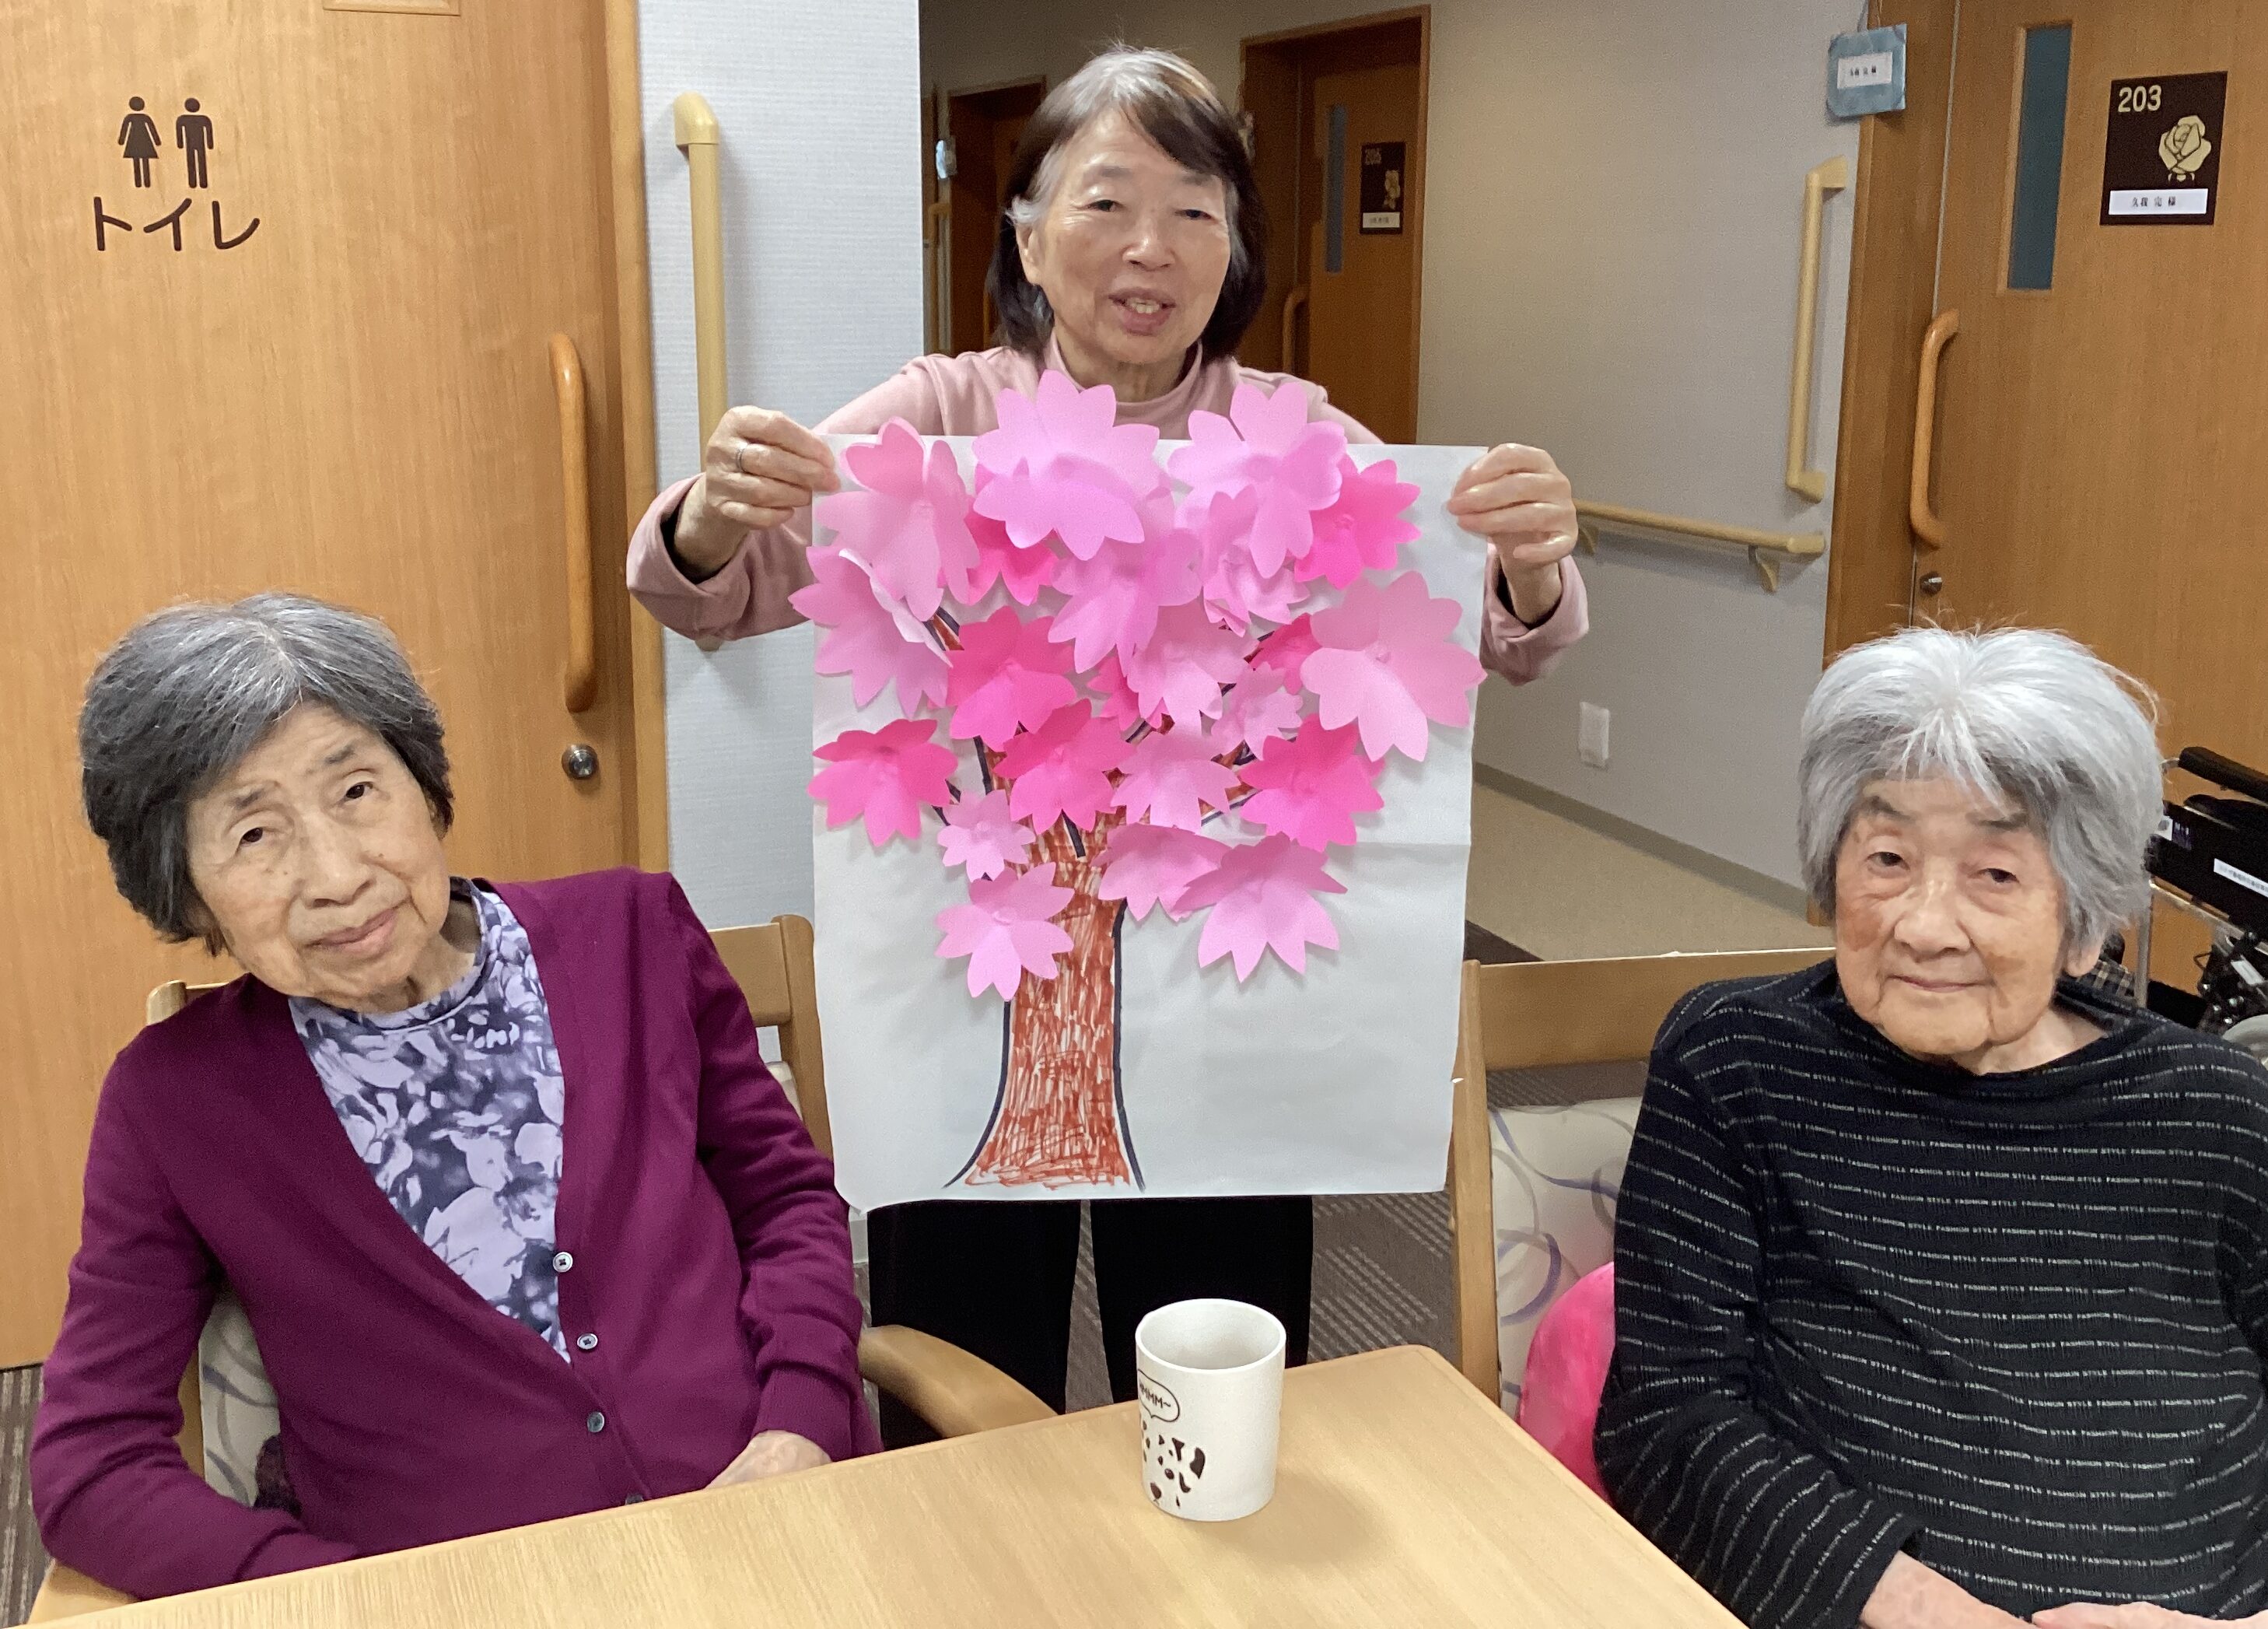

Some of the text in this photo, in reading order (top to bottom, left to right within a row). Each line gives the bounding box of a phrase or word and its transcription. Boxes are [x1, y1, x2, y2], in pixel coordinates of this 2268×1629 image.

[2117, 85, 2162, 112] 203
[93, 196, 261, 251] トイレ
